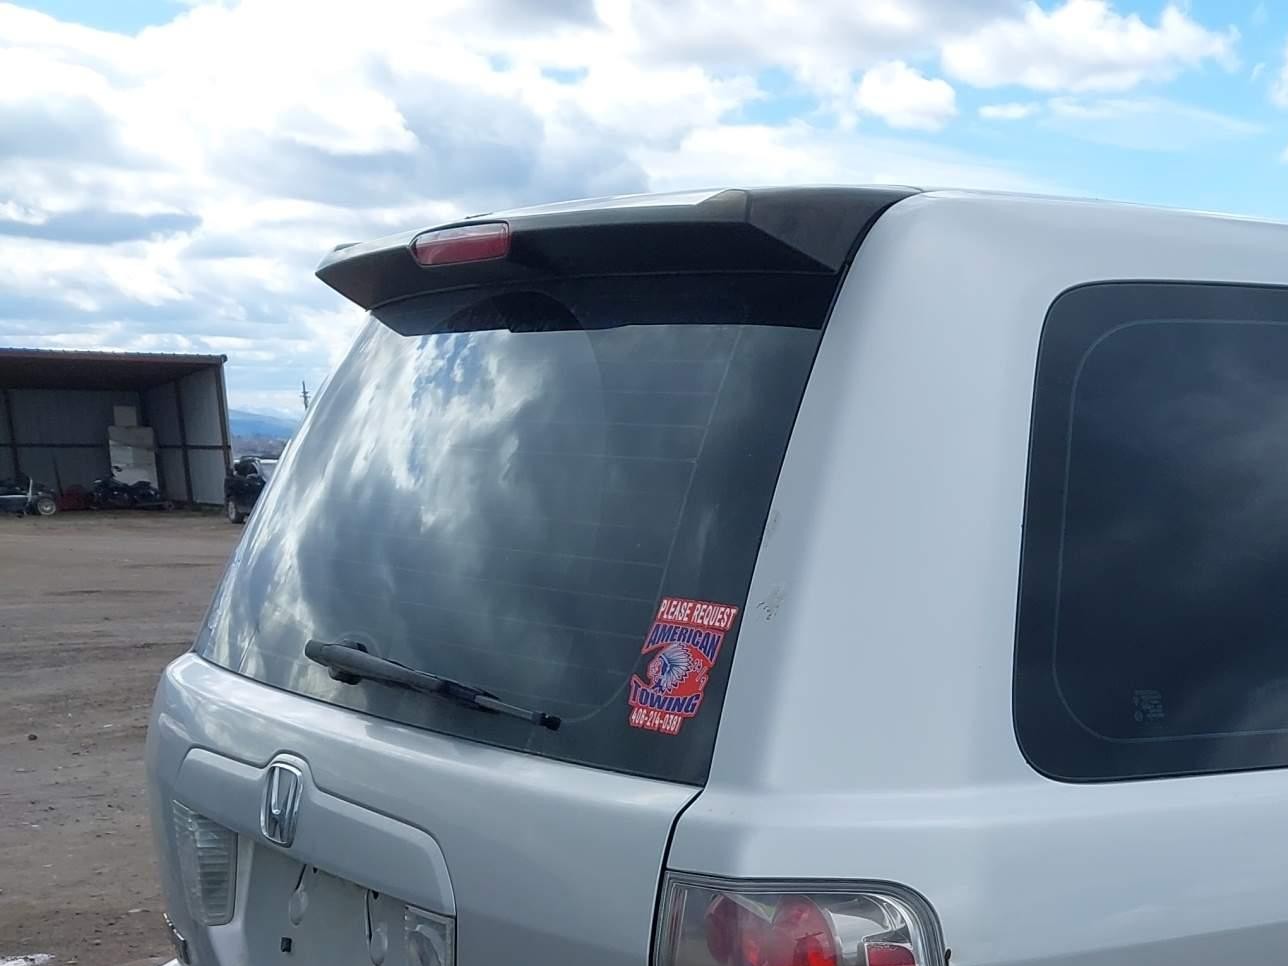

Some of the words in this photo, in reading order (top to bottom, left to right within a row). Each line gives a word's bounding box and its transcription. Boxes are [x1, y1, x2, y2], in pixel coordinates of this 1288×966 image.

[658, 599, 693, 622] PLEASE
[692, 603, 737, 628] REQUEST
[646, 623, 722, 662] AMERICAN
[630, 678, 701, 714] TOWING
